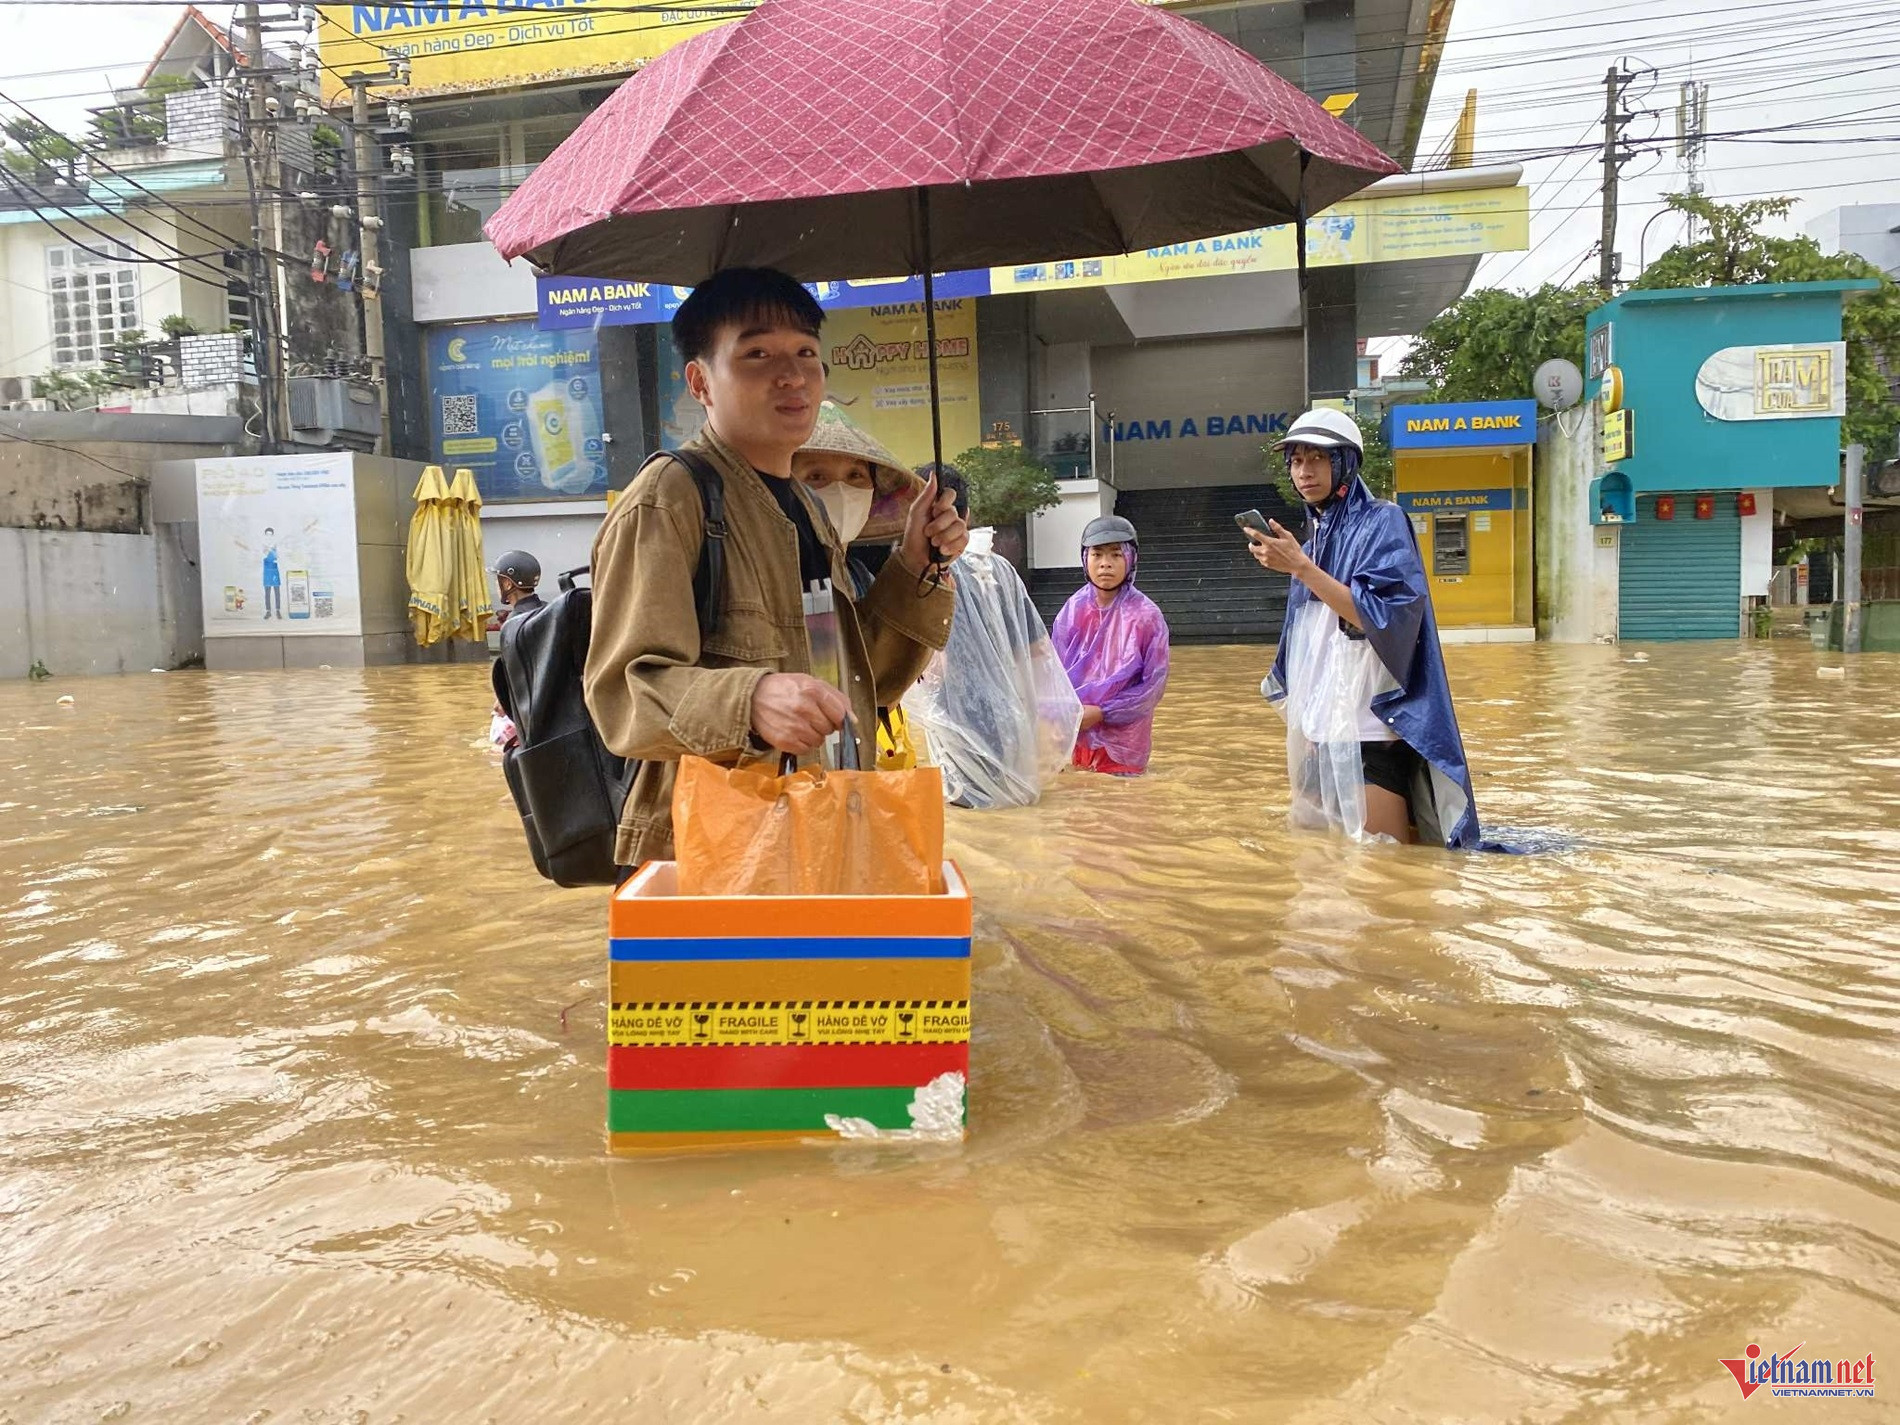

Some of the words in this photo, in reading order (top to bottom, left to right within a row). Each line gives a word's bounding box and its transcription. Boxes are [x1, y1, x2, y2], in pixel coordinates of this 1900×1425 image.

[424, 38, 460, 54] hàng
[509, 25, 542, 44] Dịch
[546, 24, 565, 38] vụ
[568, 15, 595, 34] Tốt
[1147, 243, 1189, 258] NAM
[1195, 241, 1207, 254] A
[1213, 236, 1262, 252] BANK
[548, 287, 587, 305] NAM
[590, 287, 602, 301] A
[604, 282, 652, 300] BANK
[870, 305, 906, 317] NAM
[908, 303, 919, 314] A
[1103, 420, 1171, 443] NAM
[1179, 417, 1199, 438] A
[1207, 412, 1288, 436] BANK
[1407, 418, 1450, 432] NAM
[1454, 417, 1467, 430] A
[1471, 415, 1522, 430] BANK
[1412, 497, 1441, 507] NAM
[1444, 496, 1453, 506] A
[1455, 495, 1489, 506] BANK
[611, 1016, 643, 1029] HÀNG
[719, 1016, 779, 1028] FRAGILE
[817, 1014, 850, 1027] HÀNG
